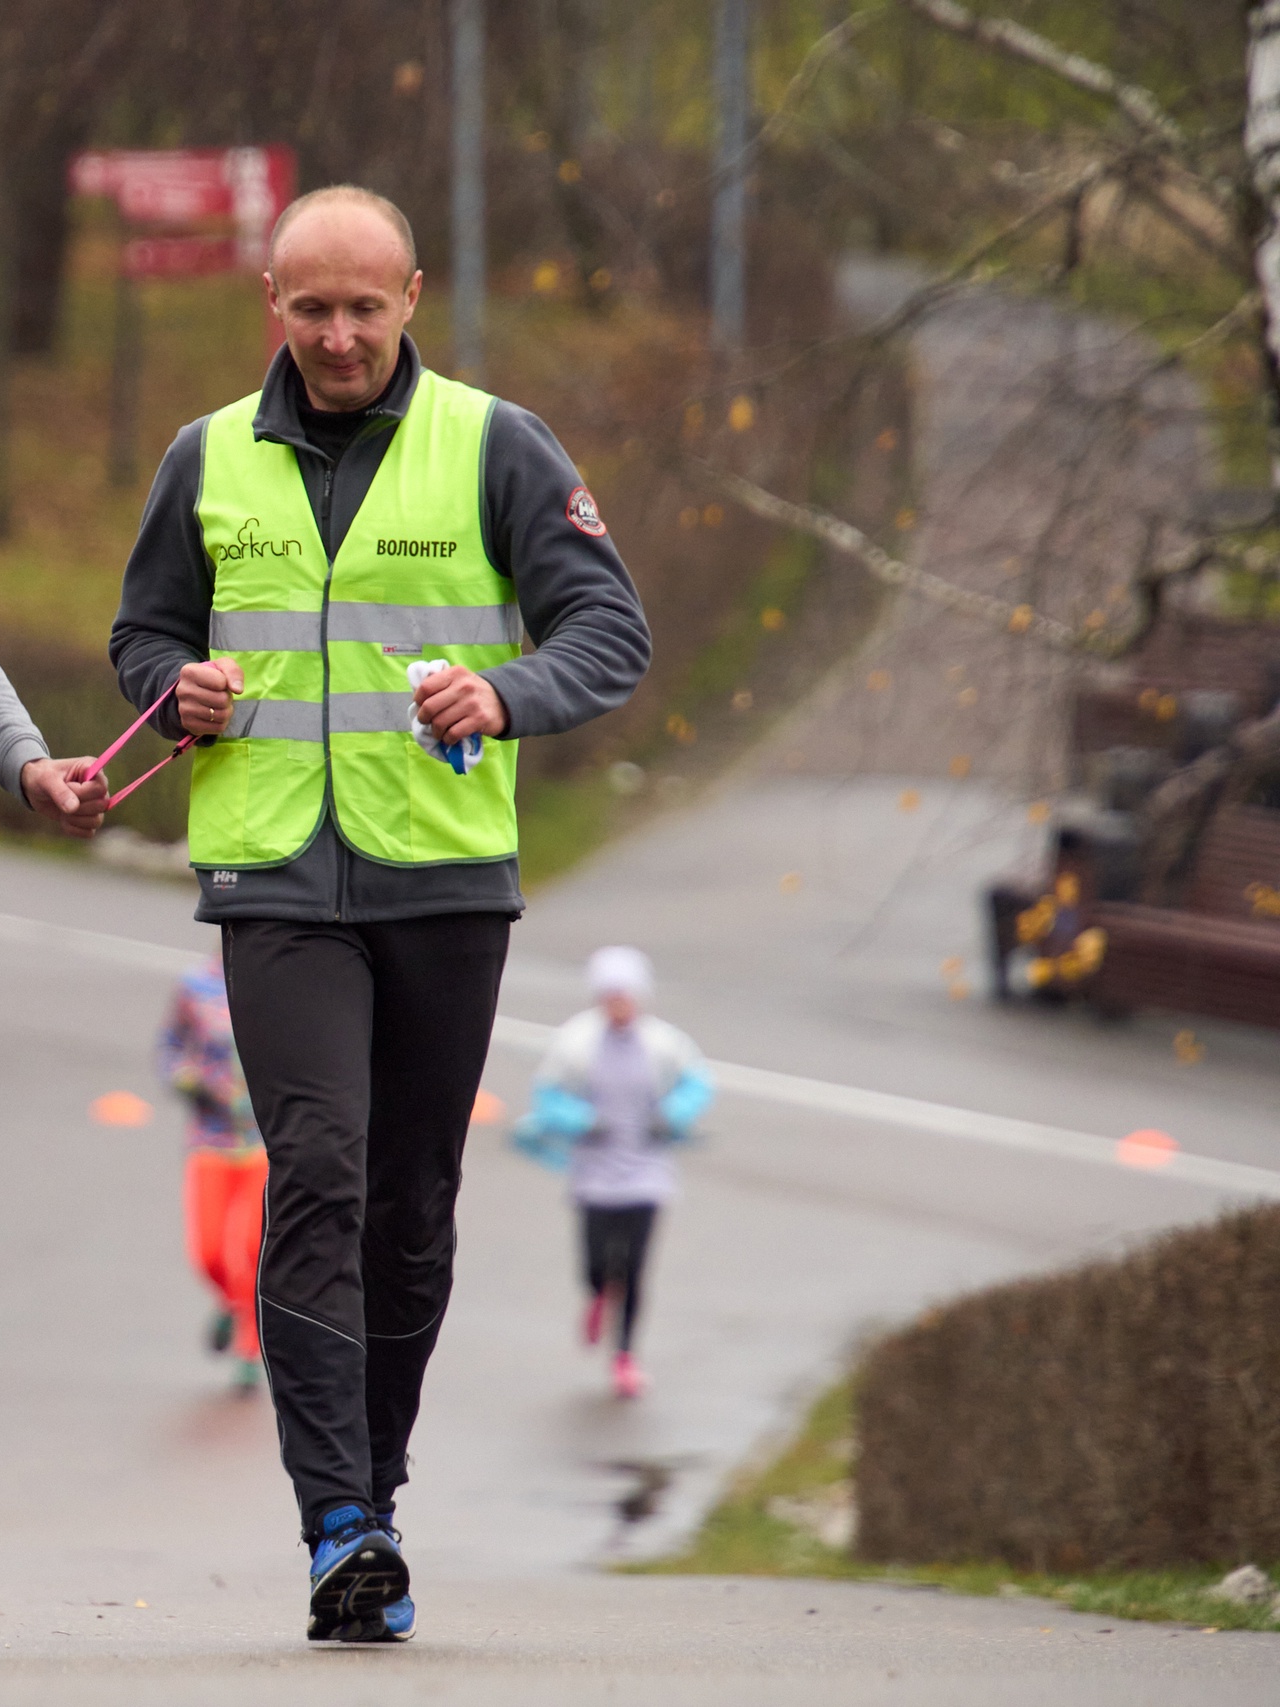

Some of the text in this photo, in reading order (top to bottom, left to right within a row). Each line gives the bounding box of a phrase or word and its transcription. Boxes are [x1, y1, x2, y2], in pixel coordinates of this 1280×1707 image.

[220, 518, 302, 565] parkrun
[376, 539, 457, 558] ВОЛОНТЕР
[213, 870, 238, 883] HH
